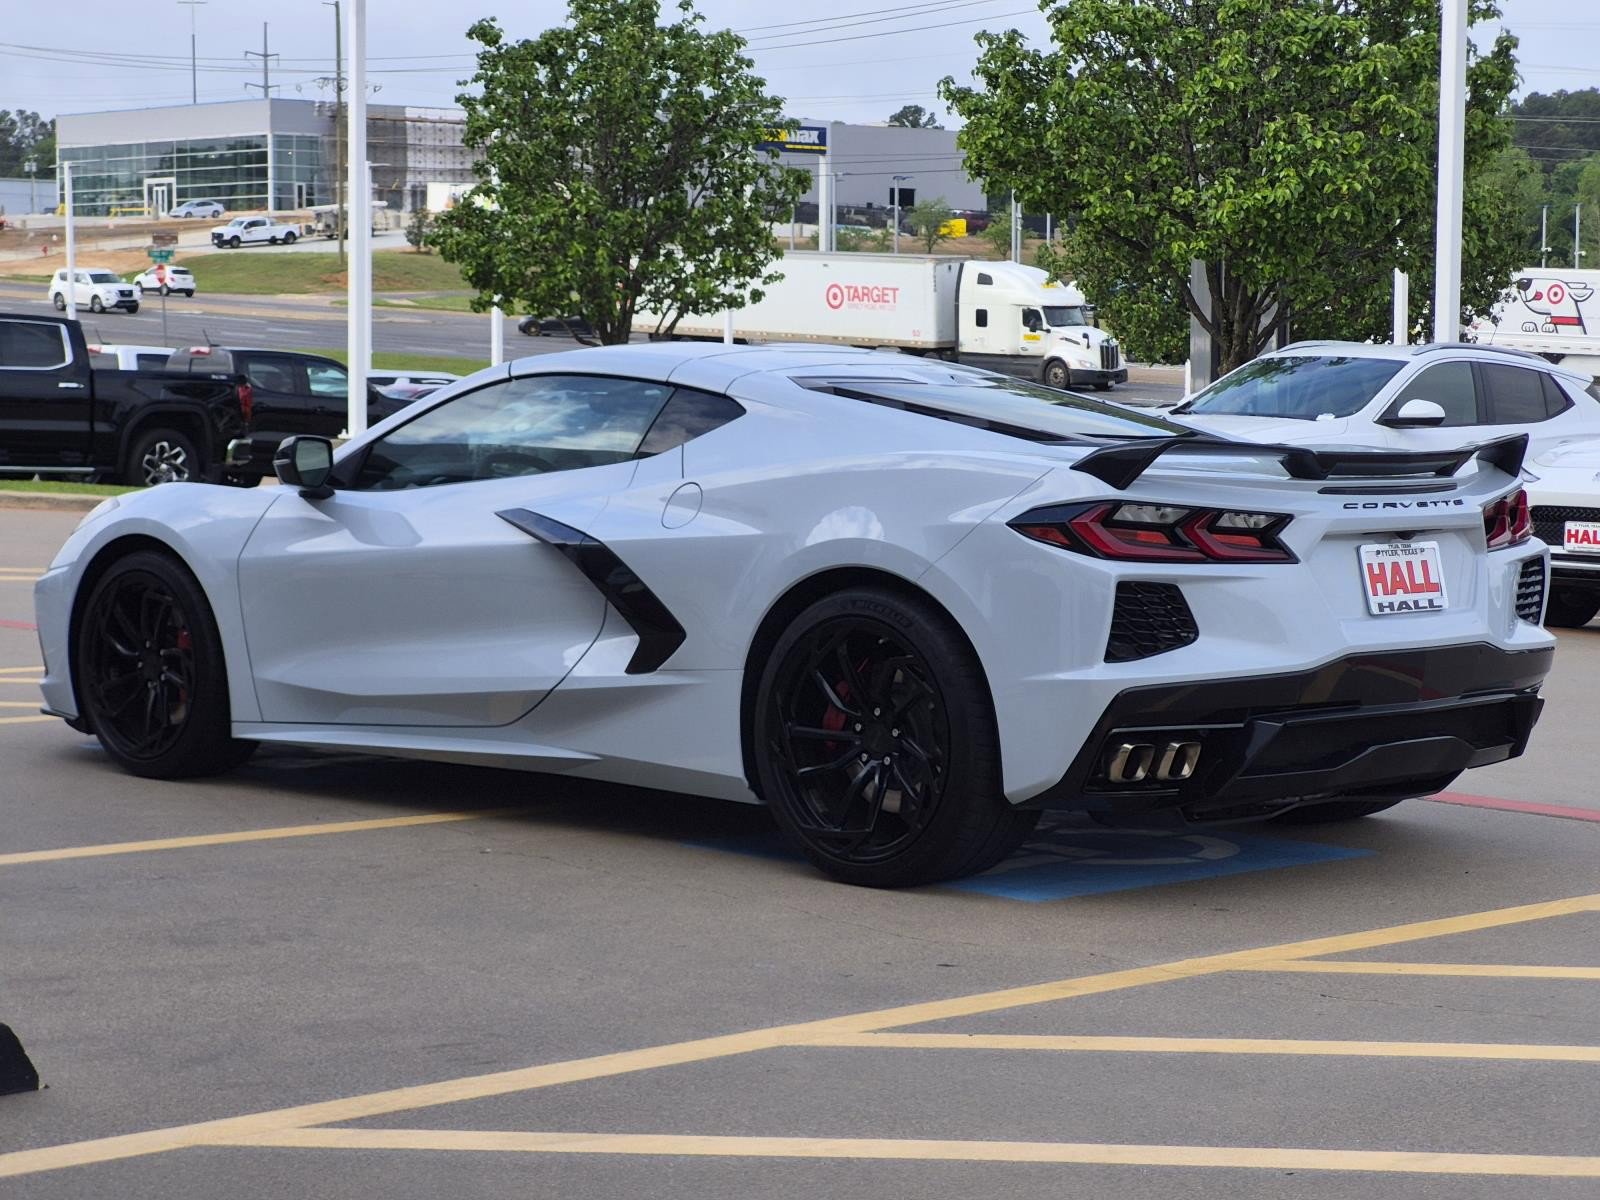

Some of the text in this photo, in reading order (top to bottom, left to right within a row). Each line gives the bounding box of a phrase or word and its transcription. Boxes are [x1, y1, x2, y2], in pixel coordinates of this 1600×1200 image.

[844, 285, 900, 303] TARGET
[1343, 499, 1464, 509] CORVETTE
[1366, 560, 1440, 596] HALL
[1378, 599, 1443, 612] HALL
